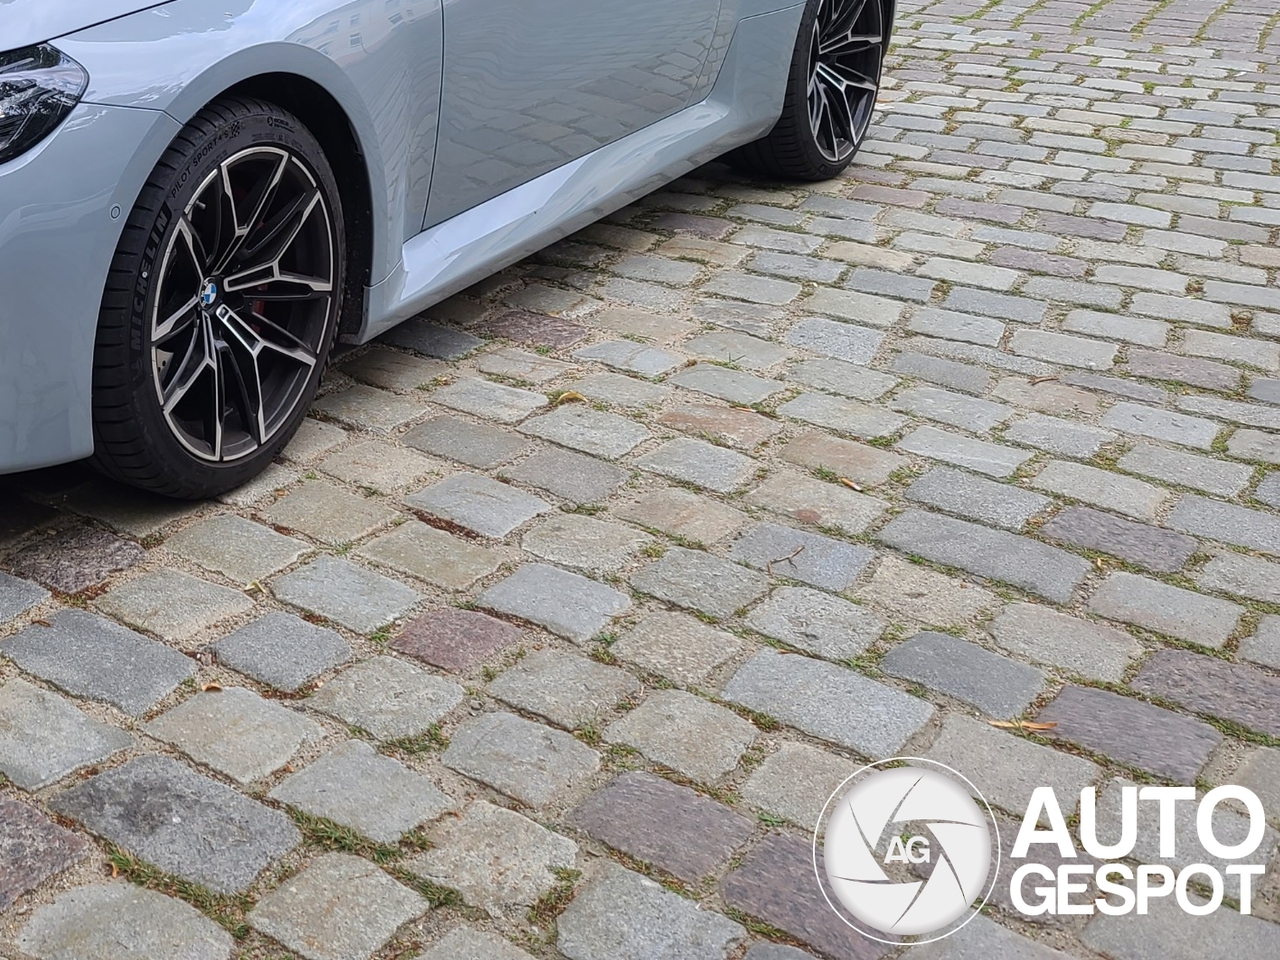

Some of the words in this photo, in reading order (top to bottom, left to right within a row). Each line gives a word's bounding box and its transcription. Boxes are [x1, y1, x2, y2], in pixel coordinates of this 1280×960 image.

[171, 165, 191, 199] PILOT
[193, 138, 218, 167] SPORT
[131, 206, 170, 351] MICHELIN
